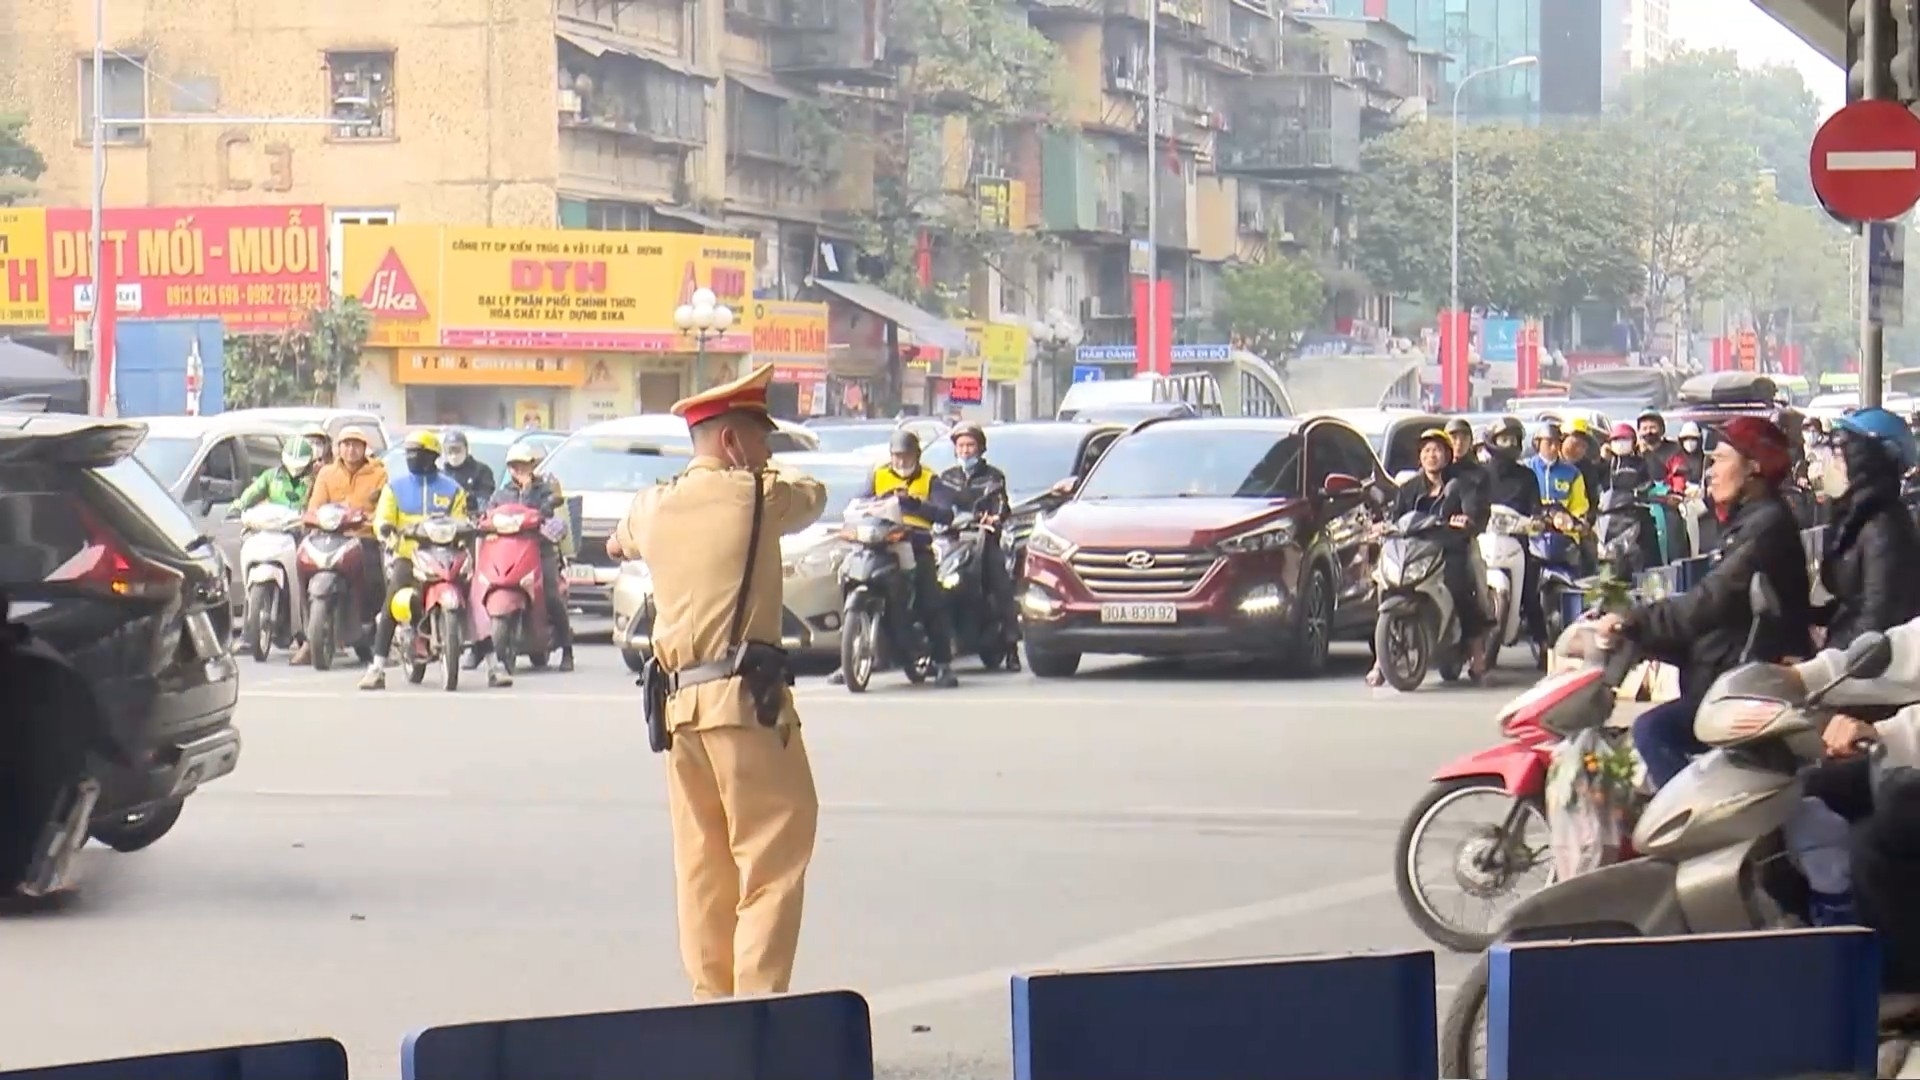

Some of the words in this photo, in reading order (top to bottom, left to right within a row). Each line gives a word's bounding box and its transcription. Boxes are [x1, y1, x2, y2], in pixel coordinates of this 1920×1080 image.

[139, 216, 204, 276] MỐI
[229, 209, 318, 274] MUỖI
[481, 241, 491, 251] TY
[363, 270, 417, 310] Sika
[511, 260, 606, 293] DTH
[601, 311, 625, 321] SIKA
